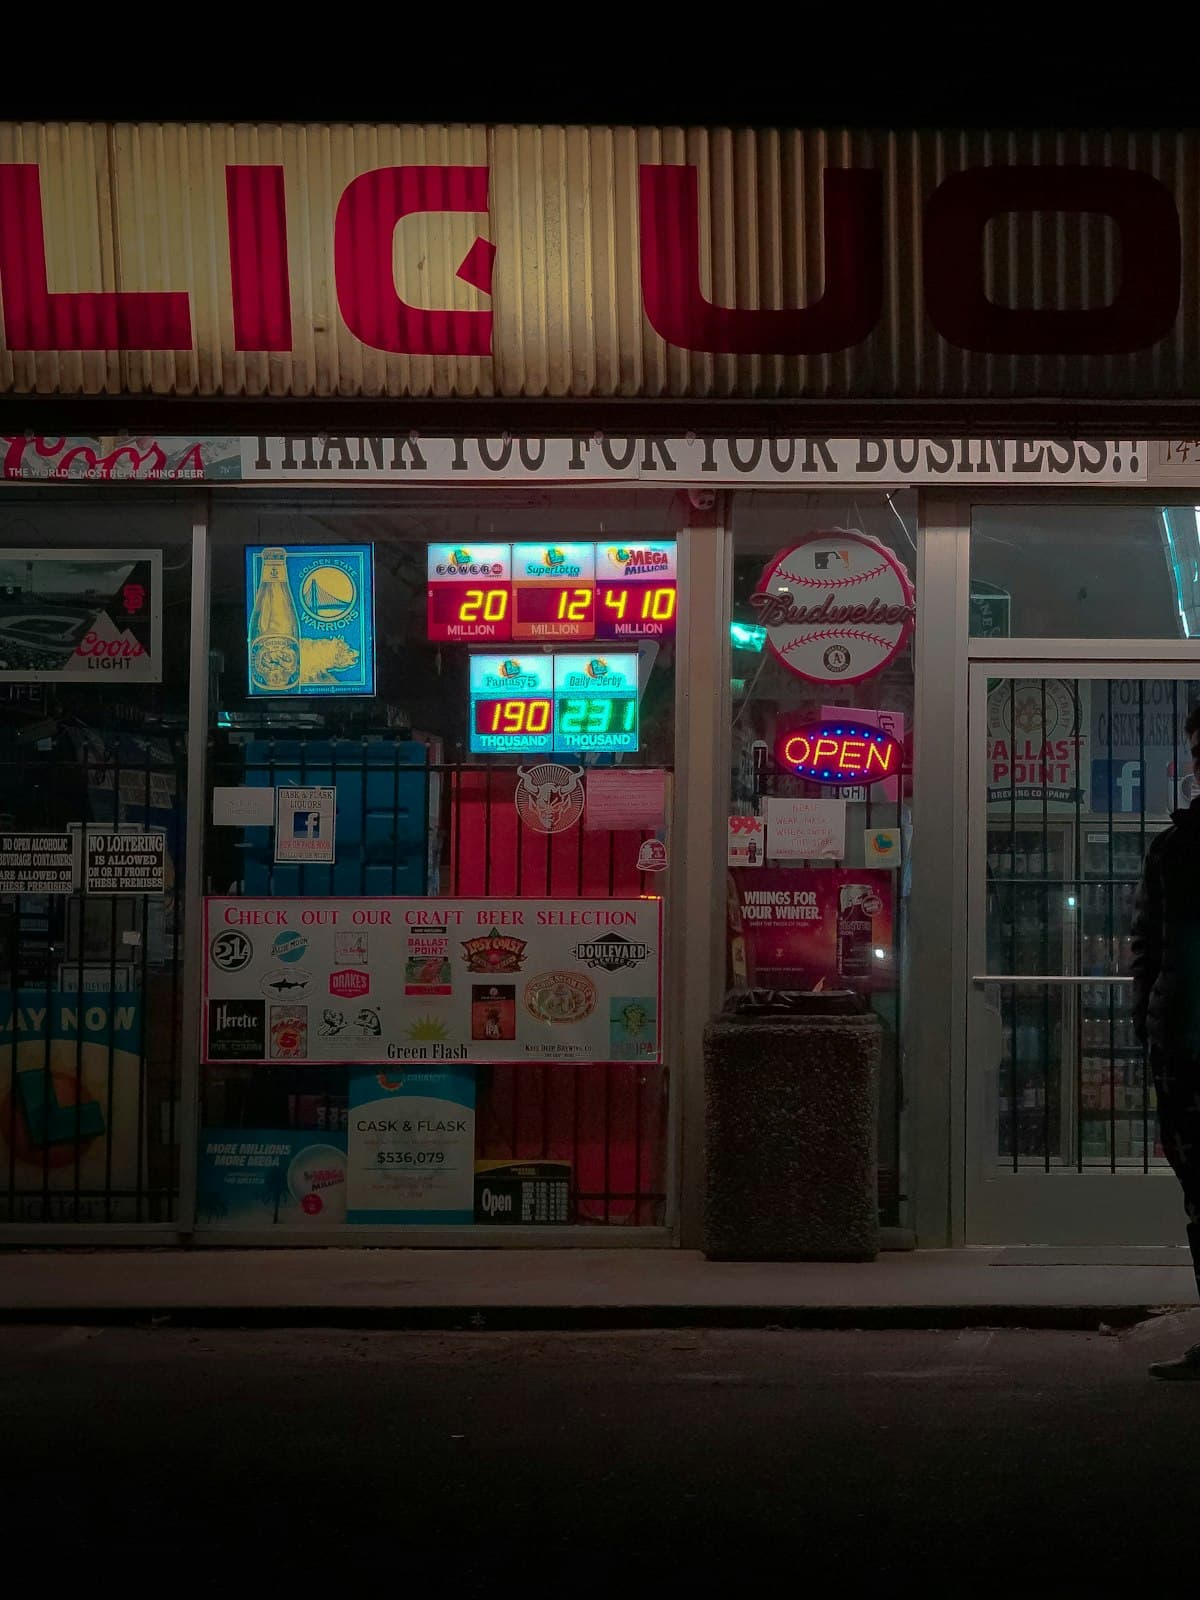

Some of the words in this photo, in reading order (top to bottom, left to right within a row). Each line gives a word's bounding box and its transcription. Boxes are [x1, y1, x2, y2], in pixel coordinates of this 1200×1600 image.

[9, 467, 30, 478] THE
[79, 468, 109, 479] MOST
[110, 468, 175, 480] REFRESHING
[177, 468, 205, 480] BEER
[630, 549, 668, 565] MEGA
[624, 564, 669, 577] MILLIONS
[458, 588, 508, 622] 20
[556, 588, 592, 622] 12
[750, 592, 916, 627] Budweiser
[301, 609, 359, 632] WARRIORS
[447, 624, 496, 636] MILLION
[530, 623, 579, 635] MILLION
[614, 623, 663, 635] MILLION
[76, 631, 147, 658] Coors
[87, 657, 131, 670] LIGHT
[491, 701, 550, 732] 190
[561, 700, 635, 732] 231
[480, 735, 548, 748] THOUSAND
[565, 735, 632, 748] THOUSAND
[785, 736, 893, 772] OPEN
[14, 838, 31, 850] OPEN
[32, 838, 68, 850] ALCOHOLIC
[89, 836, 105, 852] NO
[107, 836, 163, 852] LOITERING
[33, 853, 73, 866] CONTAINERS
[94, 855, 106, 865] IS
[107, 855, 158, 865] ALLOWED
[18, 870, 57, 881] ALLOWED
[59, 870, 72, 881] ON
[88, 867, 100, 877] ON
[101, 867, 113, 877] OR
[114, 867, 124, 877] IN
[124, 867, 151, 877] FRONT
[152, 867, 163, 877] OF
[0, 881, 26, 891] THESE
[89, 877, 117, 888] THESE
[119, 877, 163, 888] PREMISES
[793, 891, 817, 905] FOR
[224, 906, 288, 925] CHECK
[301, 909, 340, 925] OUT
[352, 909, 393, 925] OUR
[404, 909, 464, 925] CRAFT
[476, 909, 525, 925] BEER
[536, 910, 638, 926] SELECTION
[741, 905, 772, 920] YOUR
[407, 938, 449, 947] BALLAST
[414, 947, 444, 955] POINT
[578, 944, 645, 959] BOULEVARD
[61, 1007, 136, 1032] NOW
[216, 1004, 259, 1032] Heretic
[387, 1043, 427, 1060] Green
[431, 1043, 468, 1060] Flash
[356, 1120, 398, 1132] CASK
[401, 1120, 413, 1132] &
[417, 1120, 467, 1132] FLASK
[207, 1143, 237, 1155] MORE
[239, 1143, 293, 1156] MILLIONS
[214, 1155, 245, 1167] MORE
[376, 1151, 445, 1165] $536,079
[482, 1187, 512, 1217] Open
